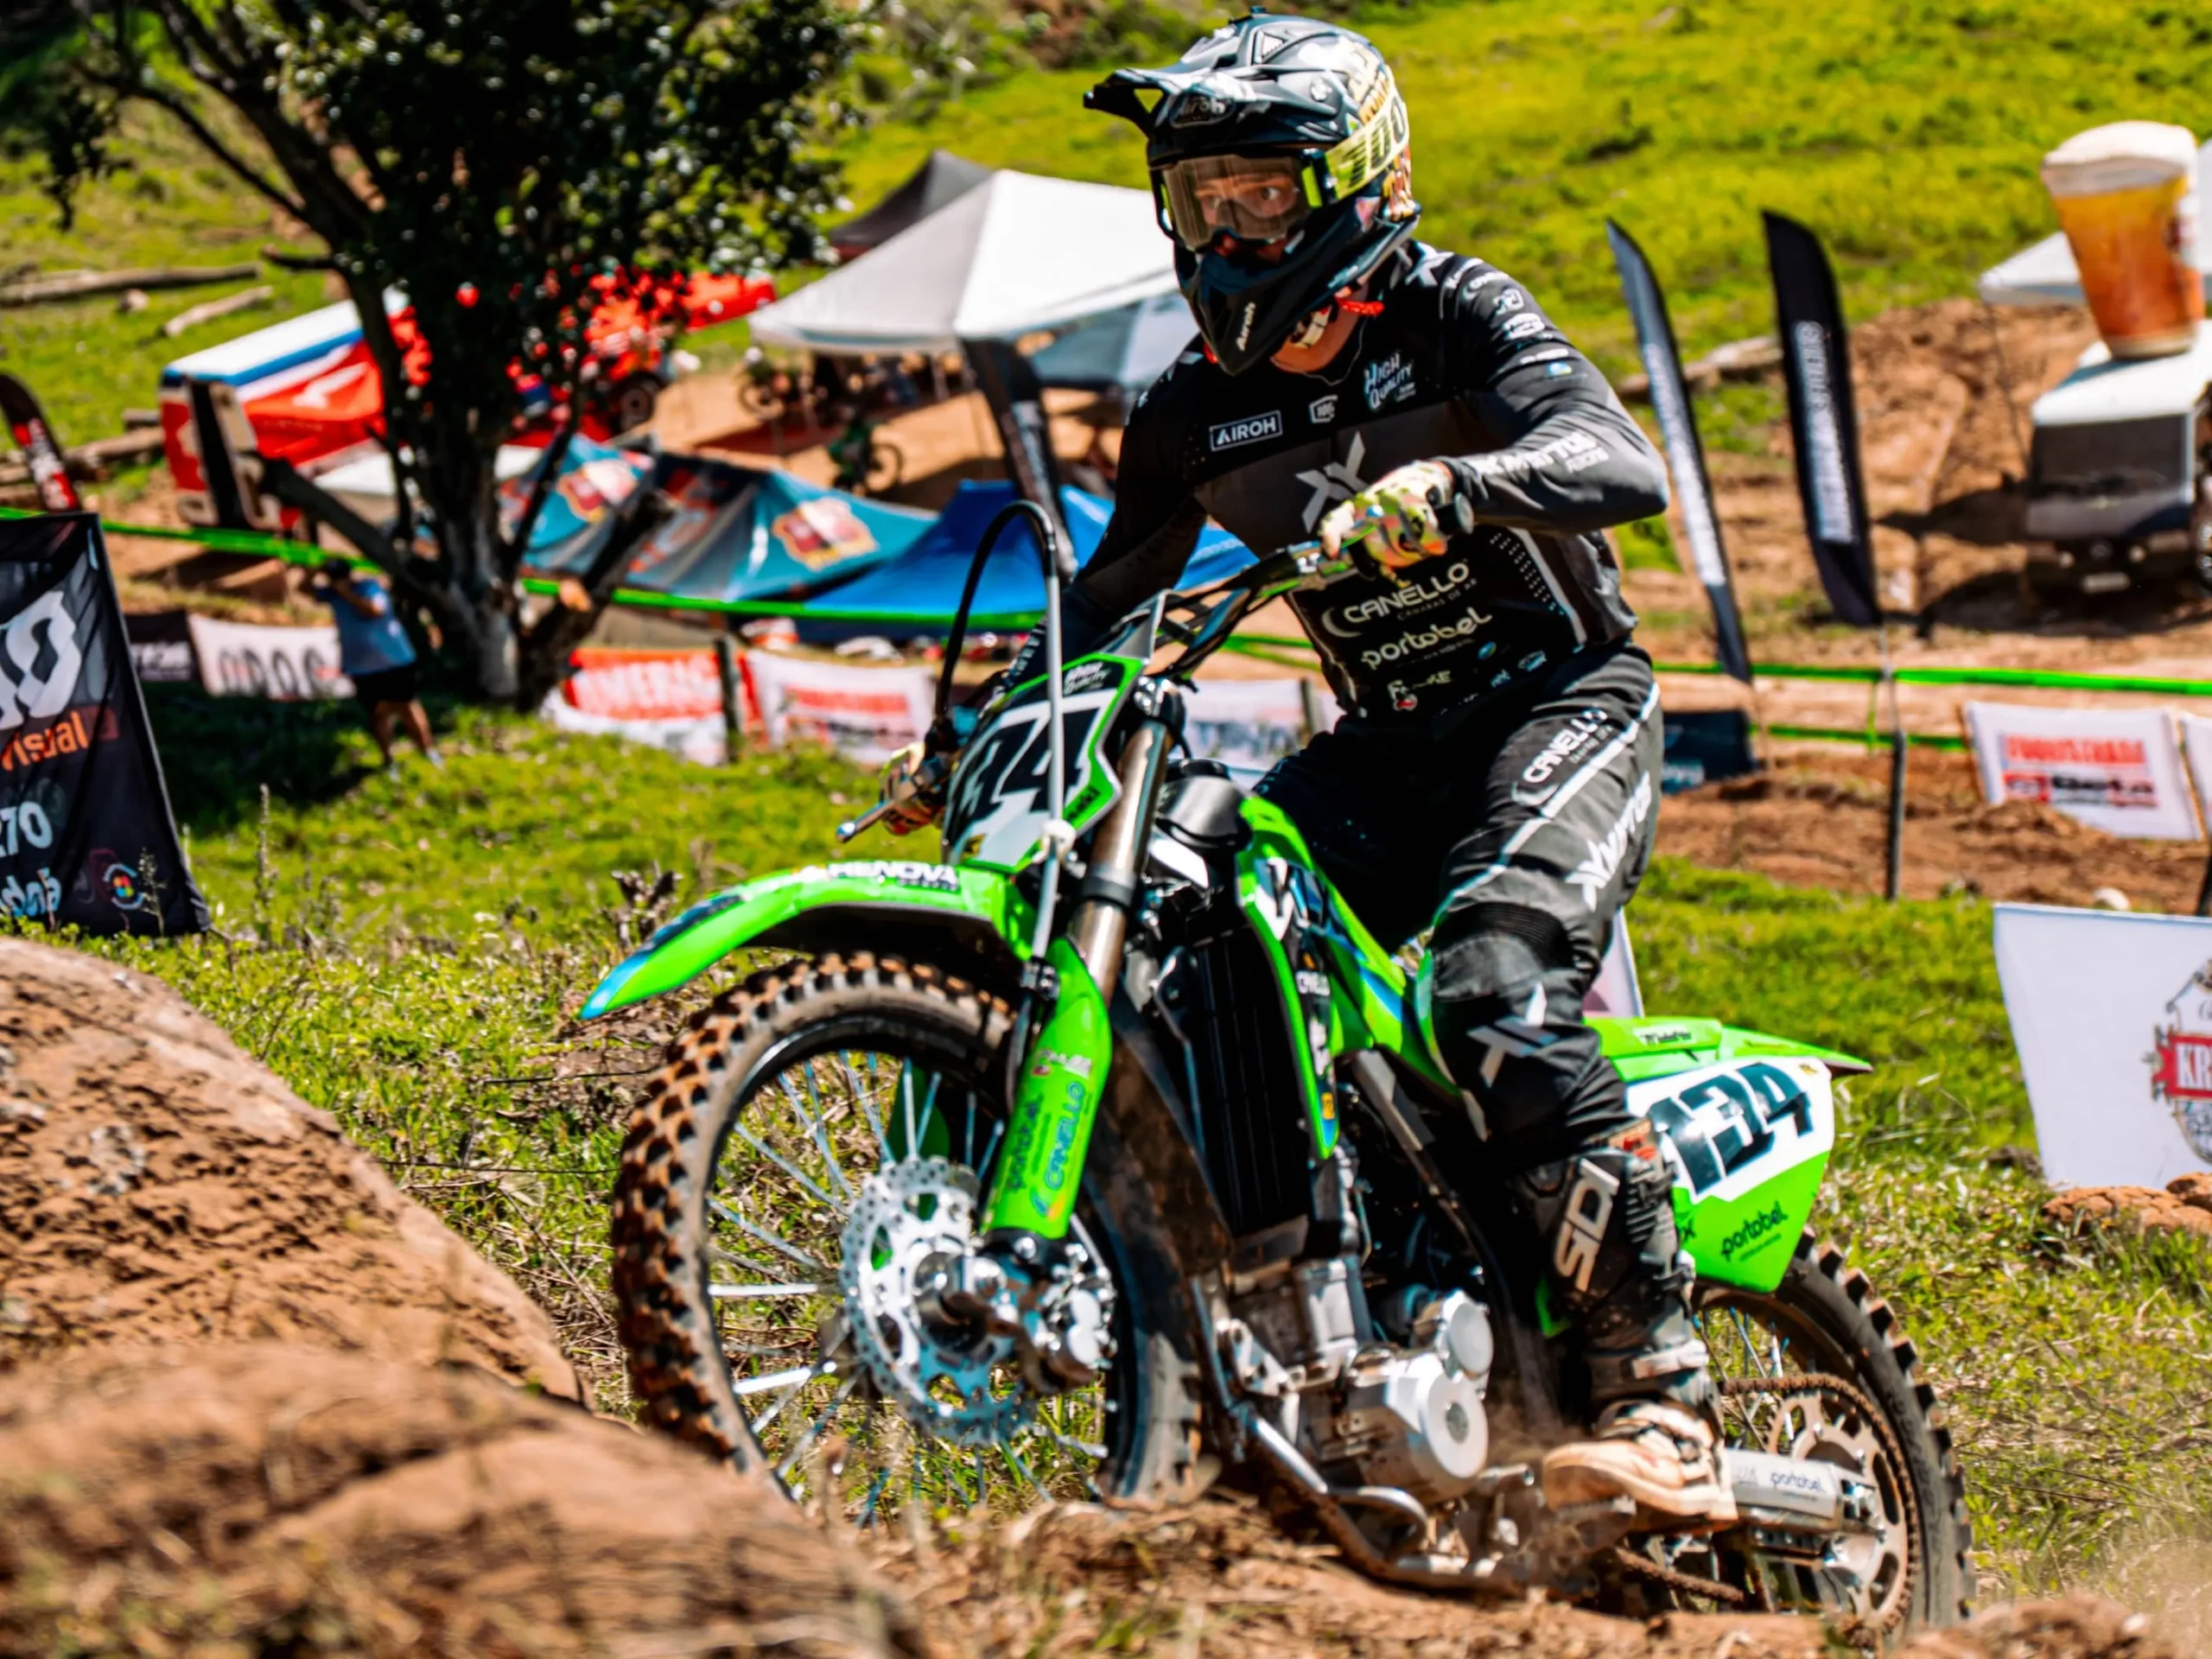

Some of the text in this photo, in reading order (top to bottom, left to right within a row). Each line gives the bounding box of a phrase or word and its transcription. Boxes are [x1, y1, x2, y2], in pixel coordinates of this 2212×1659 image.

[1217, 416, 1276, 445] AIROH
[1344, 563, 1470, 623] CANELLO
[1361, 607, 1493, 671] portobel
[1522, 709, 1609, 783] CANELLO
[1649, 1063, 1815, 1196] 134
[1720, 1199, 1789, 1263] portobel
